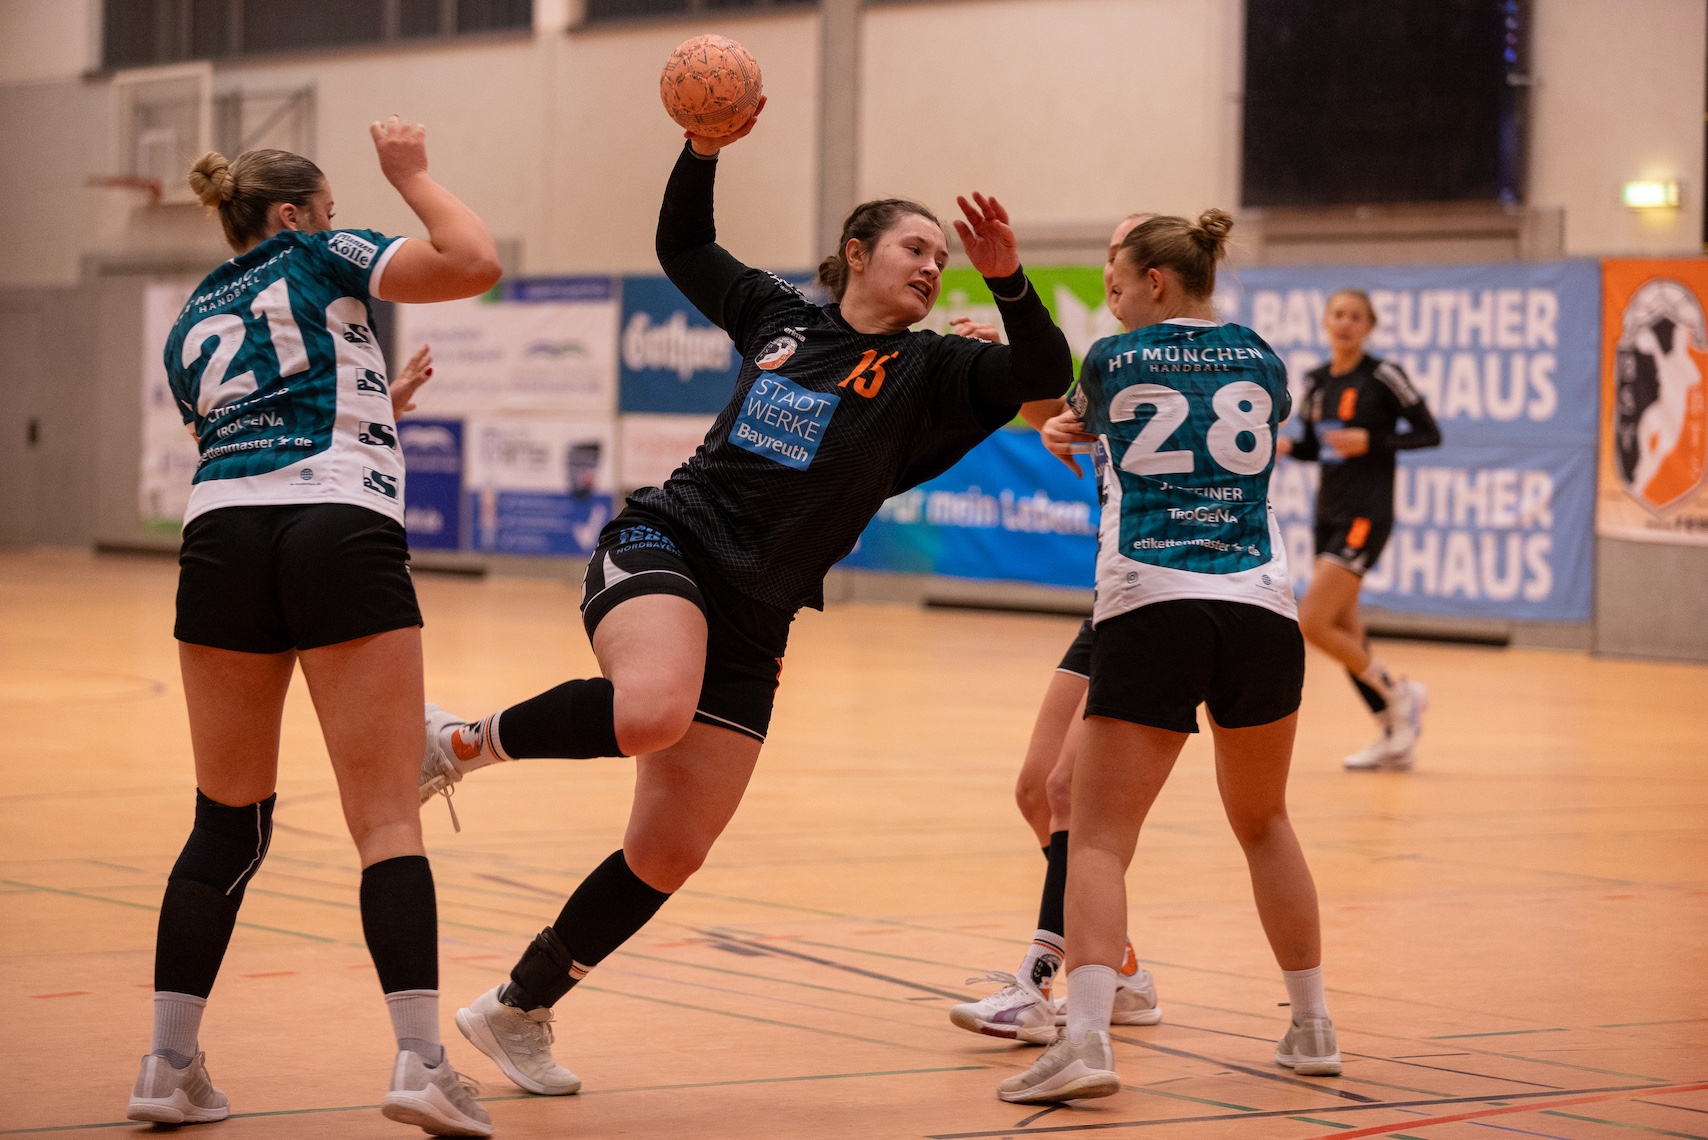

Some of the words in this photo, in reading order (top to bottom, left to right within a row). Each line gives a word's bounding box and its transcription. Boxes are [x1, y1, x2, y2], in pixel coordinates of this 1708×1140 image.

[330, 239, 368, 266] Kölle
[198, 276, 260, 314] HANDBALL
[182, 276, 310, 417] 21
[783, 326, 806, 343] erima
[837, 348, 900, 399] 15
[1108, 350, 1138, 373] HT
[1142, 345, 1264, 363] MÜNCHEN
[1150, 363, 1230, 373] HANDBALL
[755, 378, 832, 418] STADT
[747, 396, 820, 443] WERKE
[1108, 380, 1273, 476] 28
[736, 422, 809, 462] Bayreuth
[1132, 537, 1230, 552] etikettenmaster
